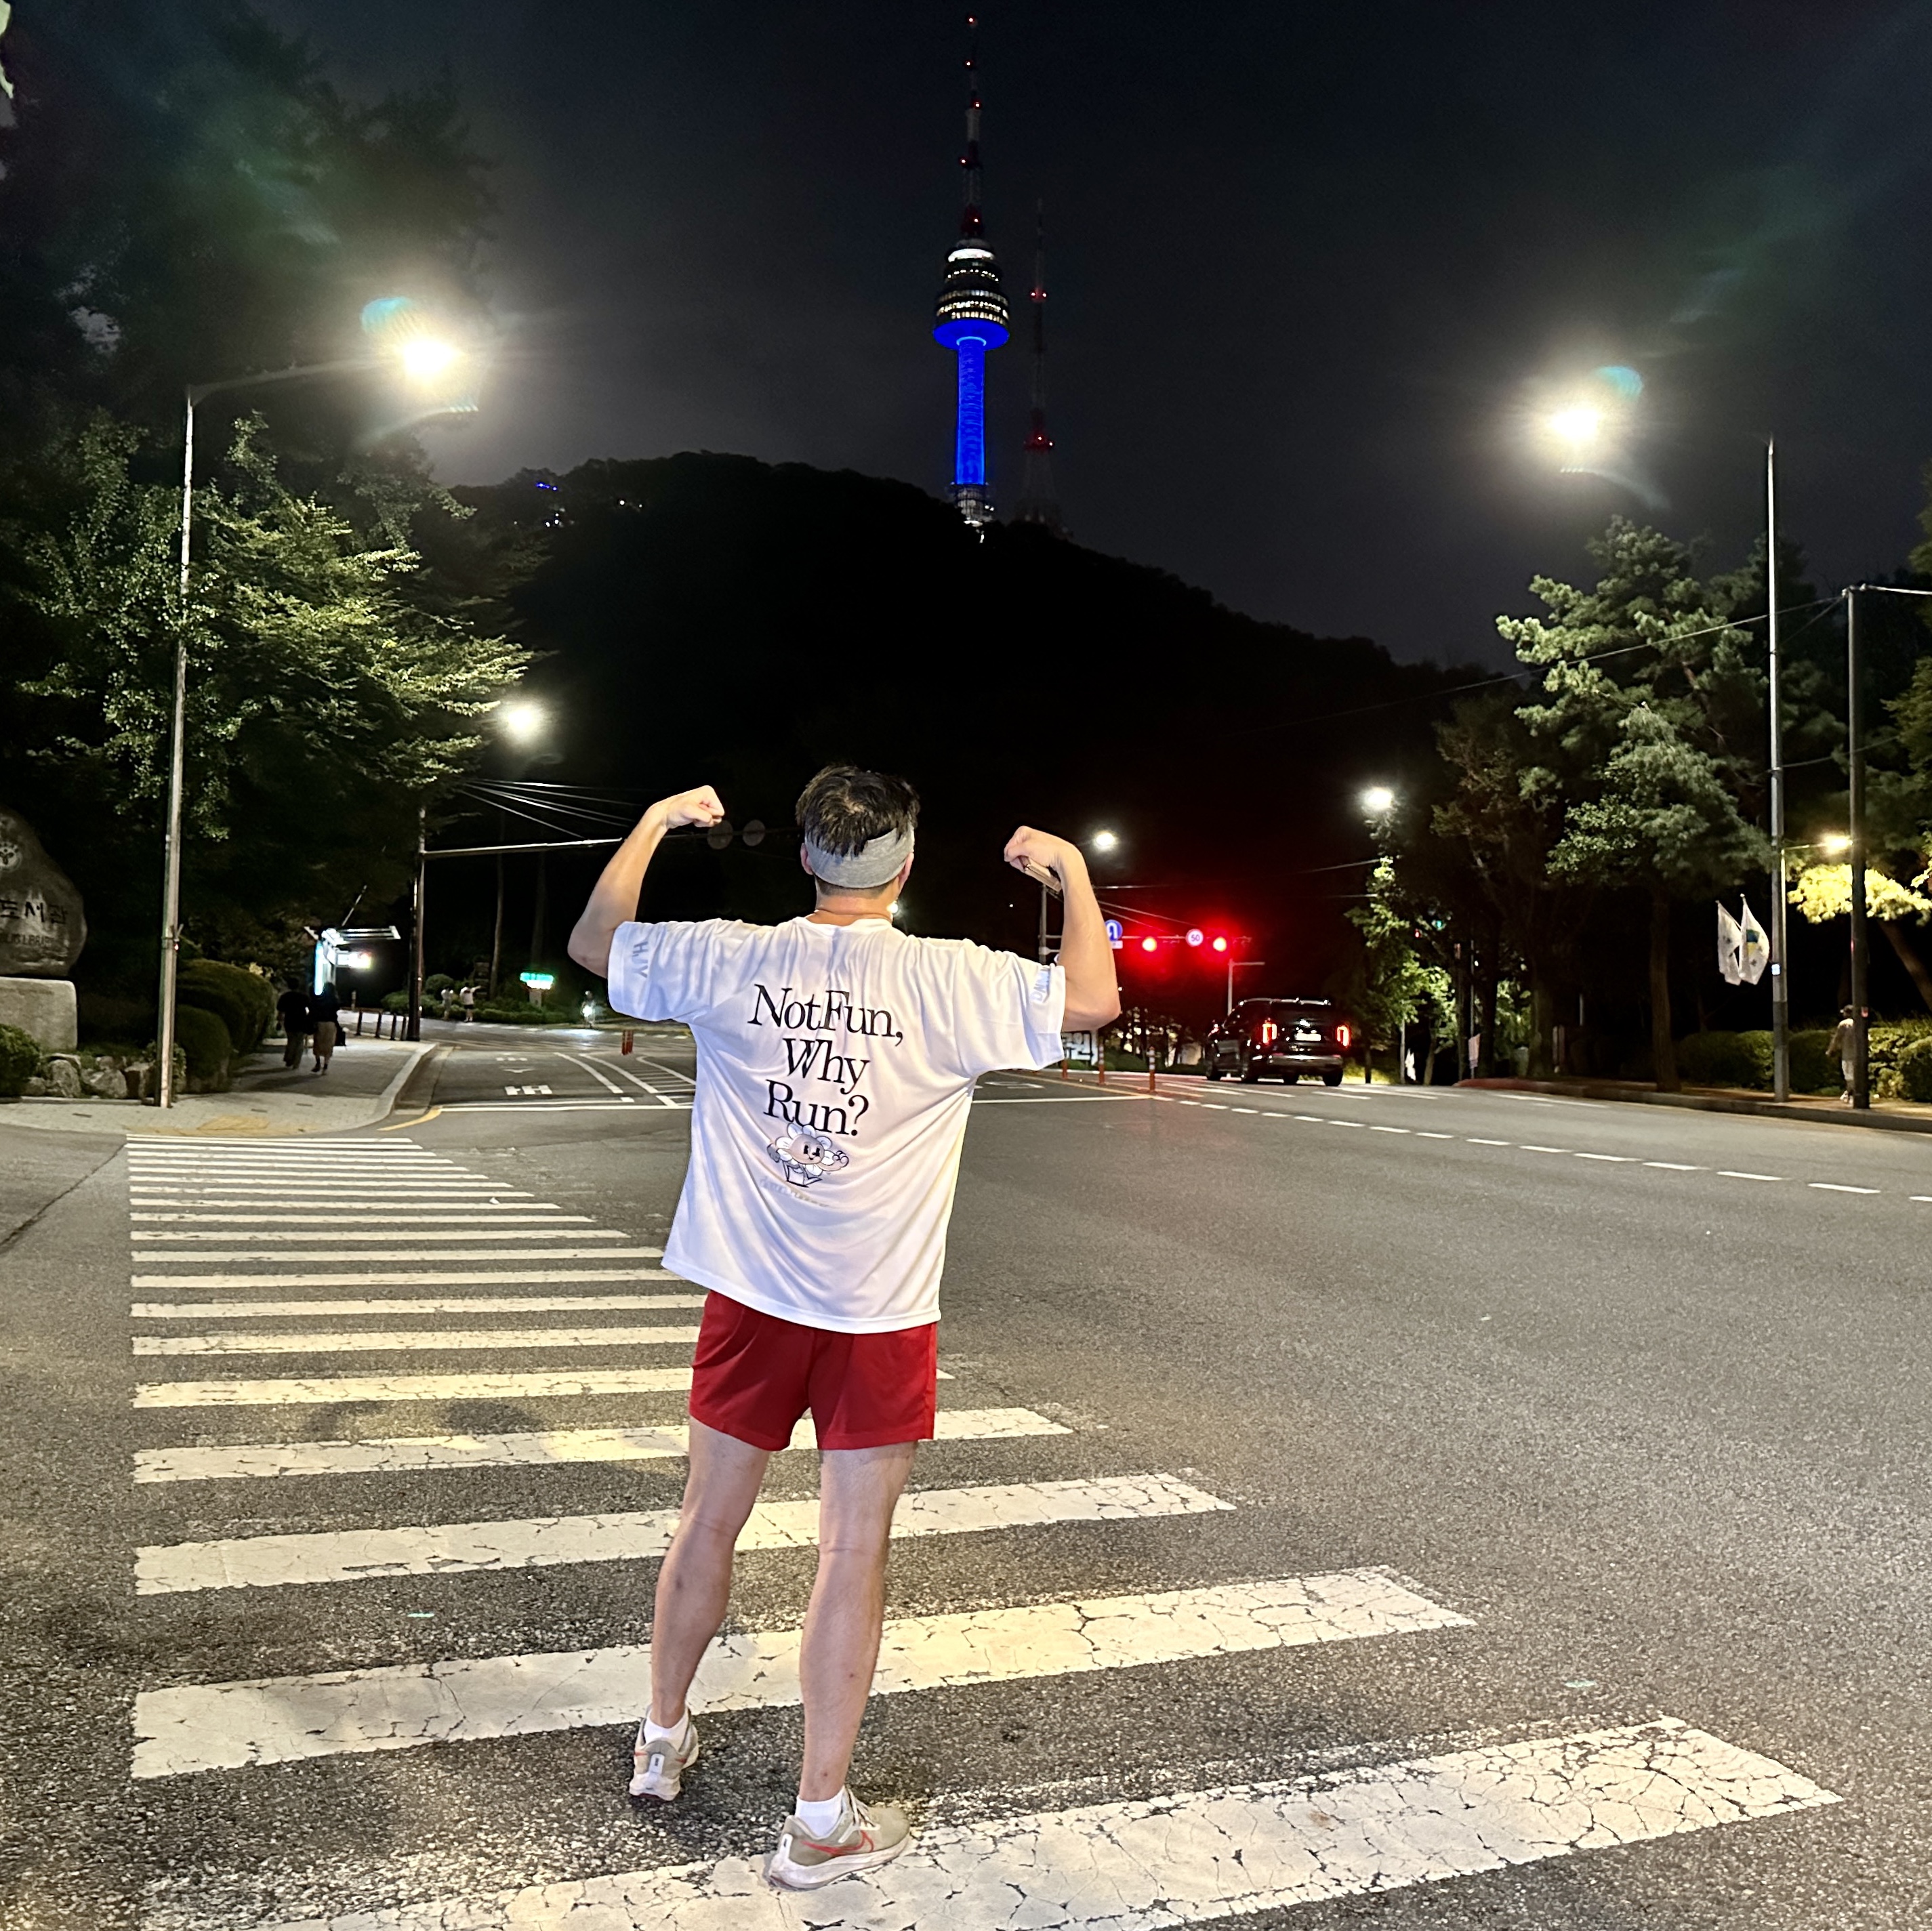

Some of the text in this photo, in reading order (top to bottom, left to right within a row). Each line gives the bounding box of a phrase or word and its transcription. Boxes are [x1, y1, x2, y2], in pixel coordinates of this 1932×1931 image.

[1191, 934, 1201, 942] 50
[783, 1038, 870, 1095] Why
[763, 1079, 869, 1136] Run?
